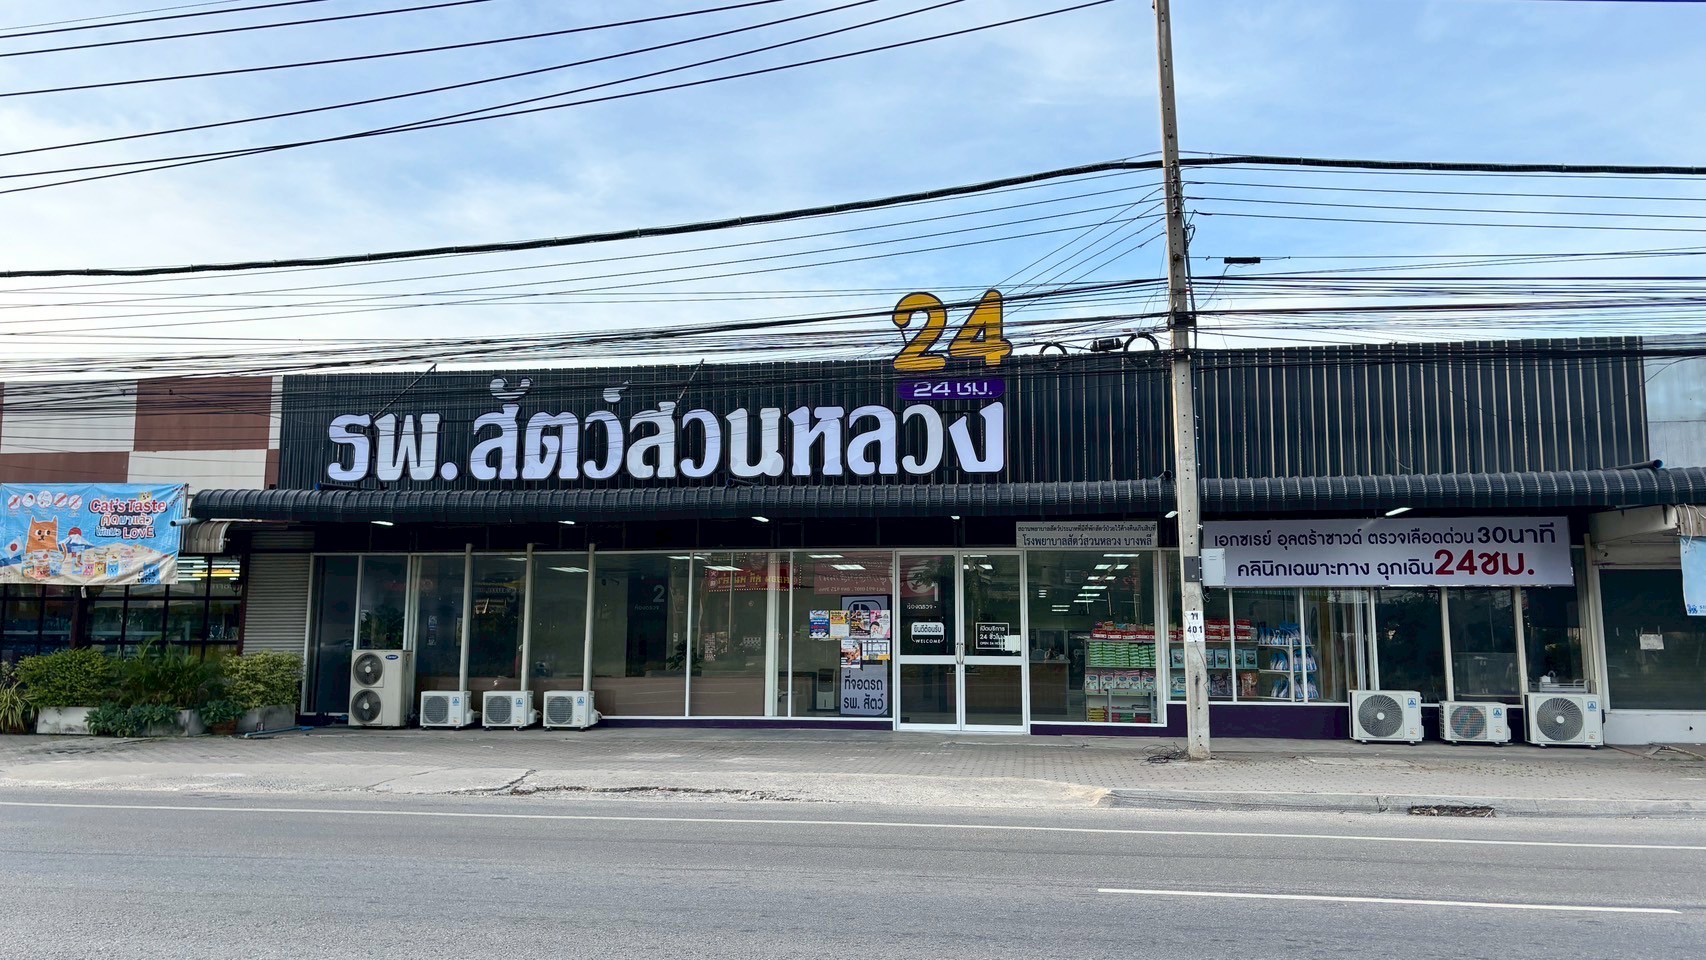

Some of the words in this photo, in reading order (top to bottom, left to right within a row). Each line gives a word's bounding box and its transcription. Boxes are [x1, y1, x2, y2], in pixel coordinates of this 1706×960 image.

[892, 288, 1013, 373] 24
[914, 382, 951, 397] 24
[90, 497, 125, 512] Cat's
[127, 498, 167, 513] Taste
[122, 526, 155, 539] LOVE
[1022, 533, 1121, 547] โรงพยาบาลสัตว์สวนหลวง
[1124, 533, 1152, 546] บางพลี
[1214, 530, 1272, 547] เอกซเรย์
[1277, 529, 1362, 550] อุลตร้าซาวด์
[1238, 560, 1370, 577] คลินิกเฉพาะทาง
[653, 584, 665, 602] 2
[1187, 625, 1203, 634] 401
[844, 670, 883, 691] ที่จอดรถ
[843, 697, 860, 709] รพ.
[863, 693, 884, 710] สัตว์
